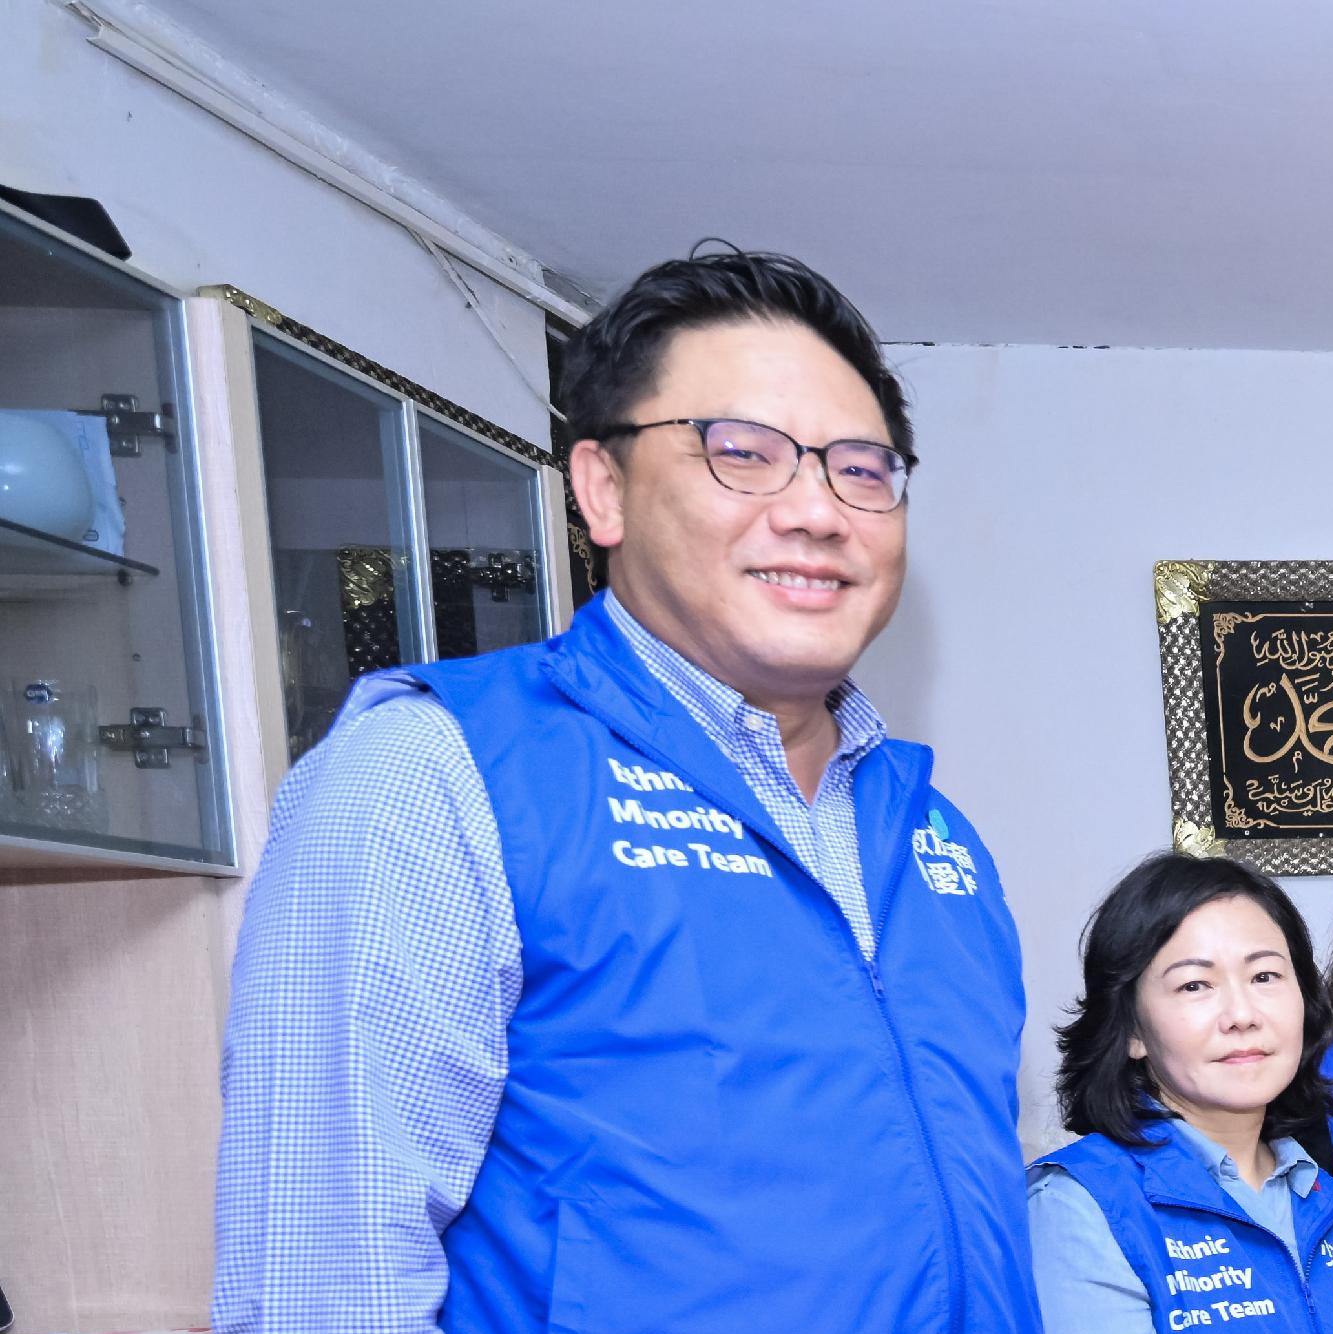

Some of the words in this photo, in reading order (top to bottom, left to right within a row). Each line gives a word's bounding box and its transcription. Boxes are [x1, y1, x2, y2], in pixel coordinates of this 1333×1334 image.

[608, 757, 694, 792] Ethn
[612, 840, 689, 869] Care
[687, 843, 773, 878] Team
[1166, 1266, 1252, 1296] Minority
[1168, 1309, 1212, 1331] Care
[1211, 1299, 1276, 1322] Team
